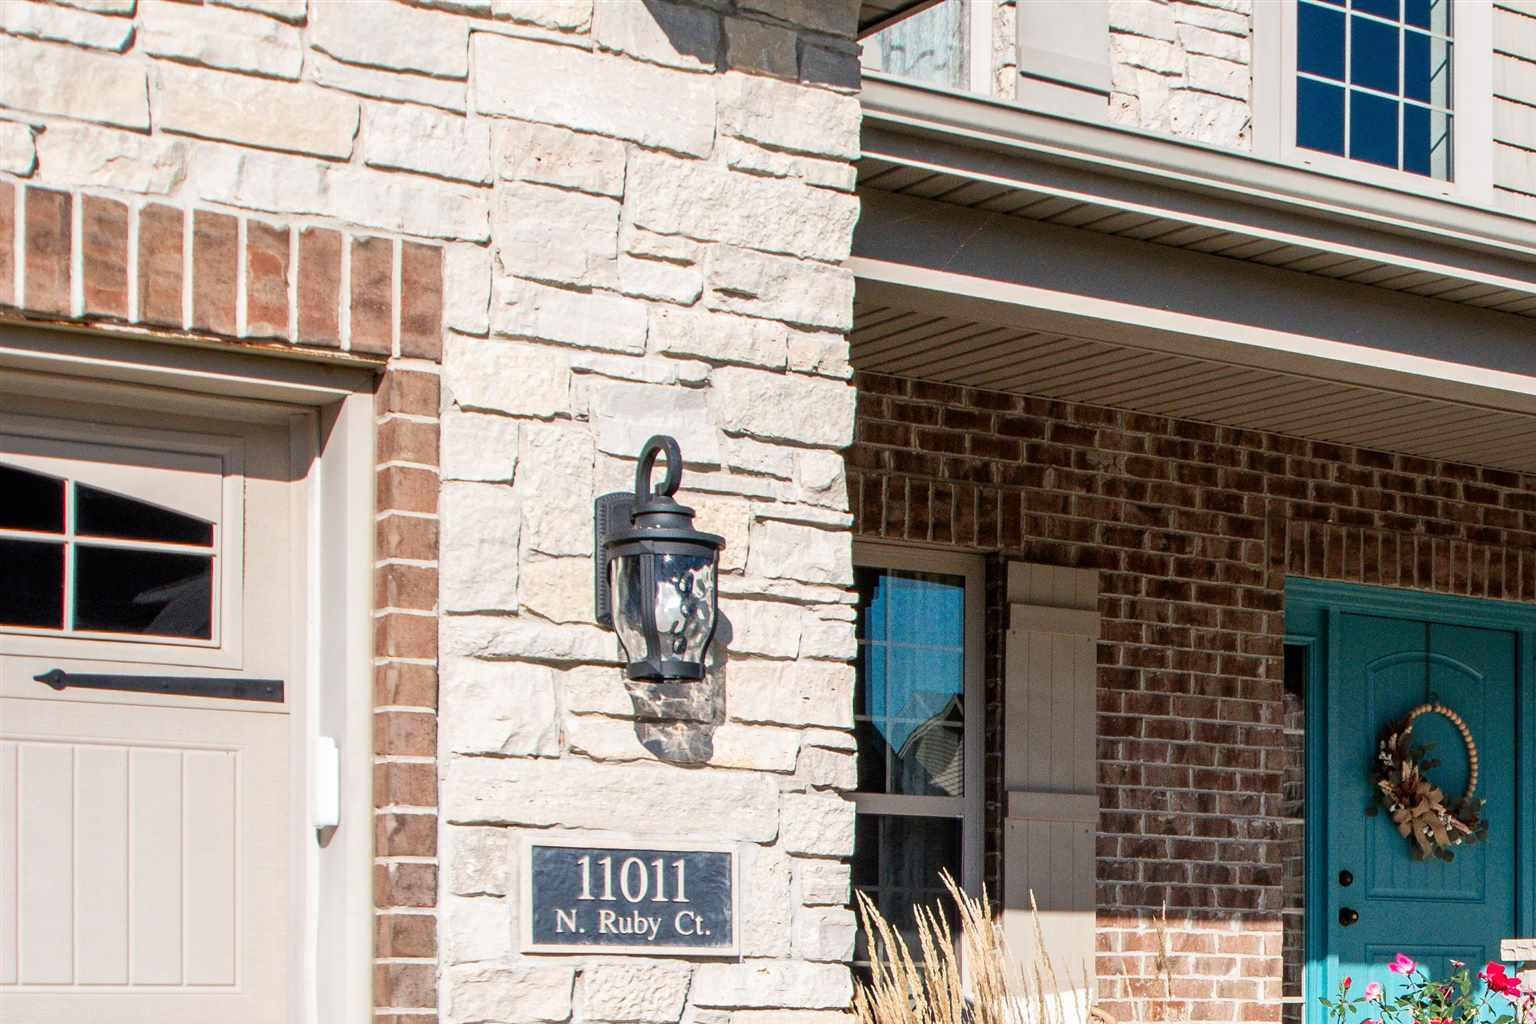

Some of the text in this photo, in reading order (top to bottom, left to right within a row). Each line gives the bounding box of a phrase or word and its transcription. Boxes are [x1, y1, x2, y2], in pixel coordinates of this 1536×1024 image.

[577, 855, 690, 903] 11011
[554, 908, 711, 941] N. Ruby Ct.
